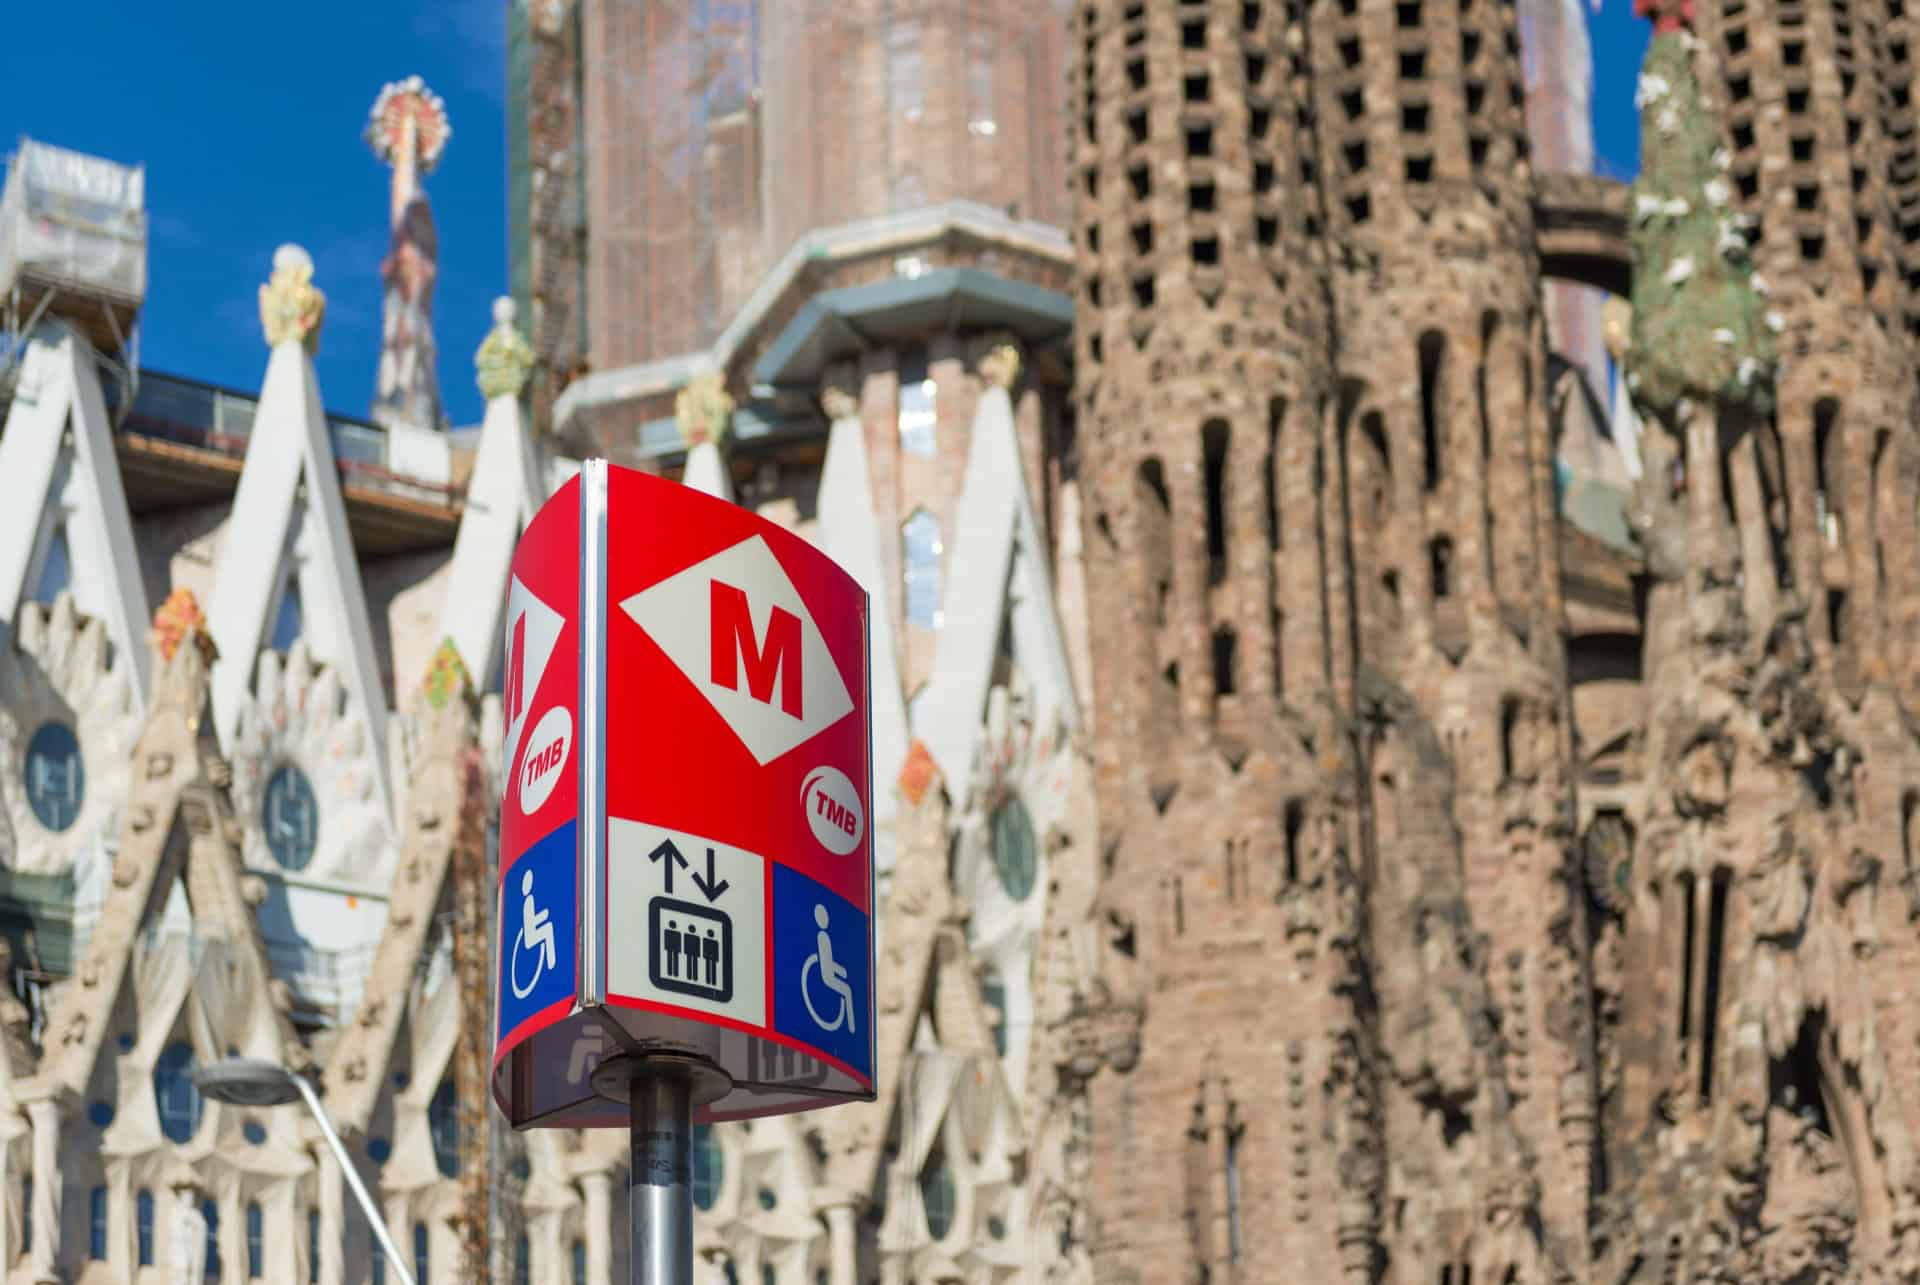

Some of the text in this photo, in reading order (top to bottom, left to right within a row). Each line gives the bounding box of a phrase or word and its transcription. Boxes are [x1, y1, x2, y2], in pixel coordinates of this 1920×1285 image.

[711, 578, 803, 721] M
[528, 736, 565, 787] TMB
[816, 789, 857, 836] TMB
